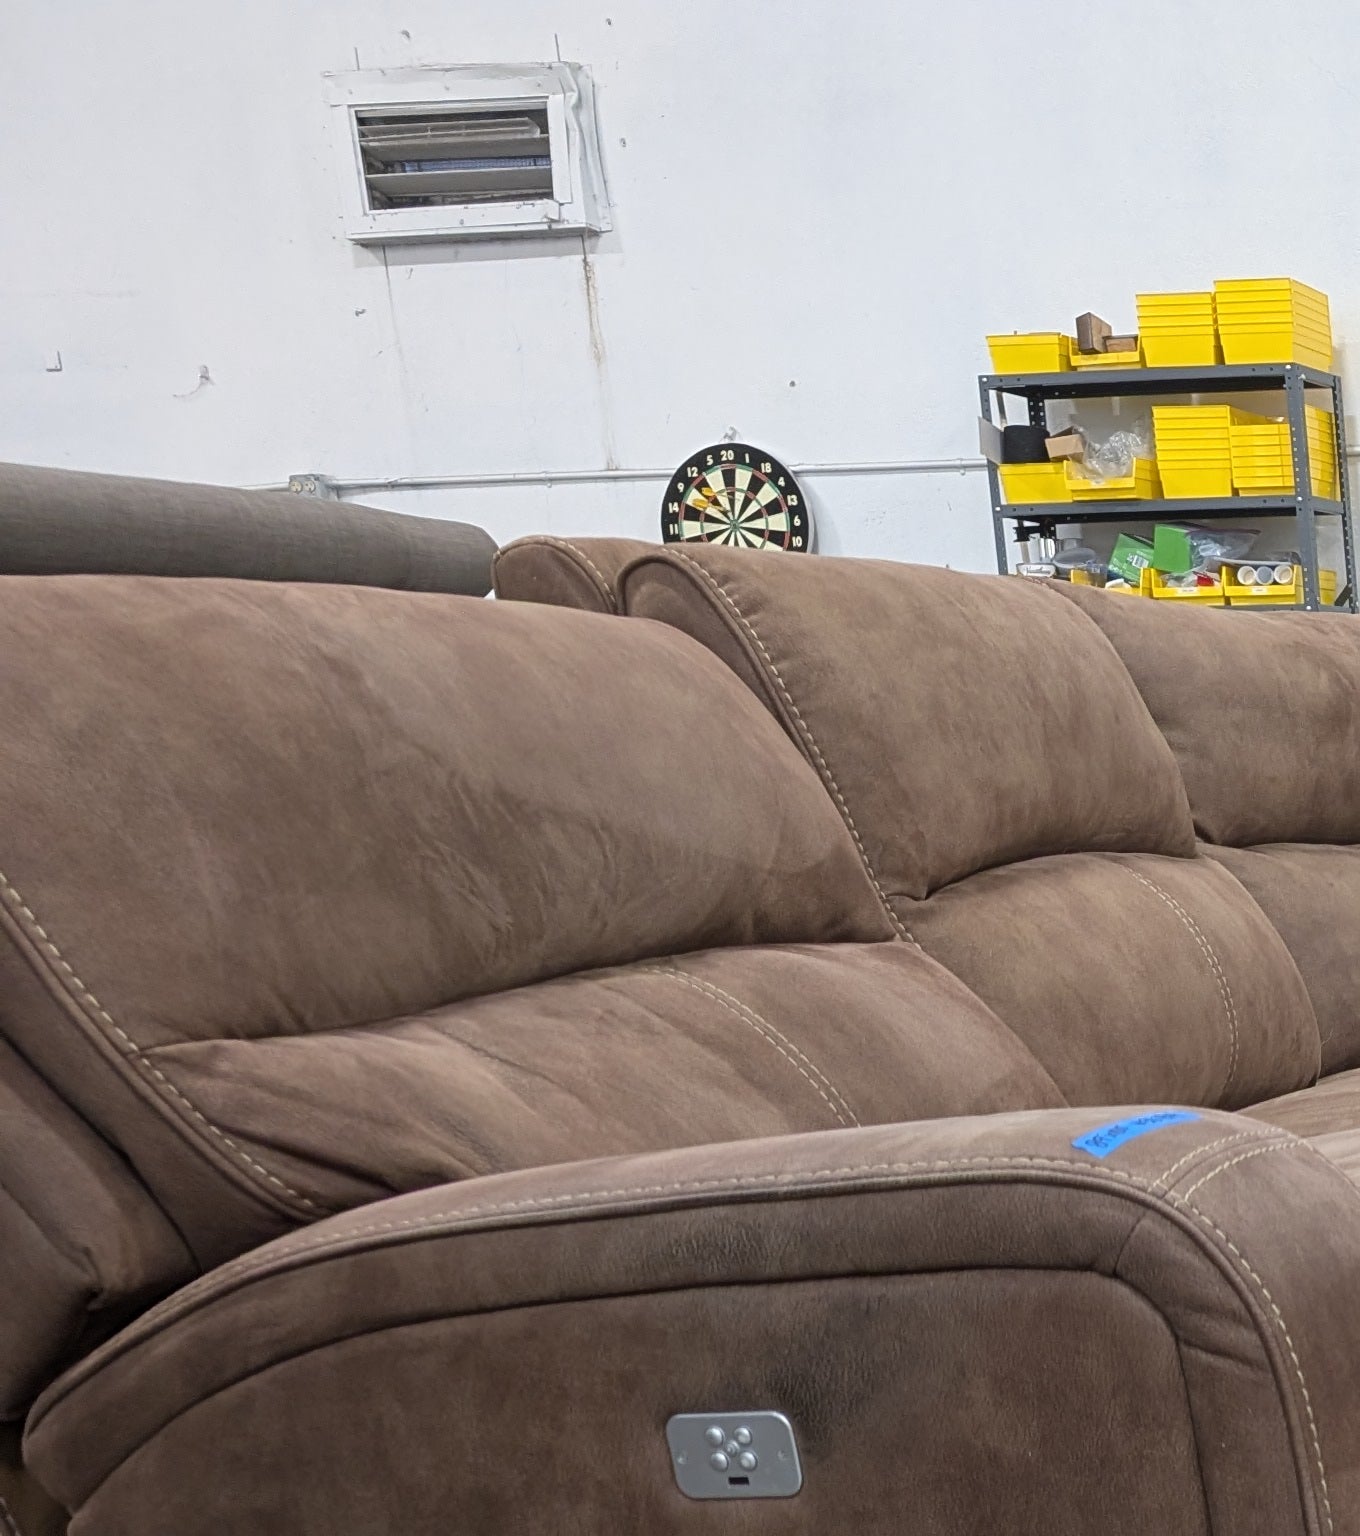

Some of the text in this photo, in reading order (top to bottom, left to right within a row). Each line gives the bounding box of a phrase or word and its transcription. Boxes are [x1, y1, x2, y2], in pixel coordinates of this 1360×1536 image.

[707, 455, 713, 465] 5
[721, 450, 734, 461] 20
[744, 453, 750, 463] 1
[687, 467, 698, 477] 12
[761, 463, 772, 473] 18
[778, 477, 785, 486] 4
[677, 483, 684, 492] 9
[787, 495, 798, 505] 13
[669, 503, 679, 513] 14
[794, 515, 801, 526] 6
[669, 523, 679, 535] 11
[792, 536, 802, 547] 10
